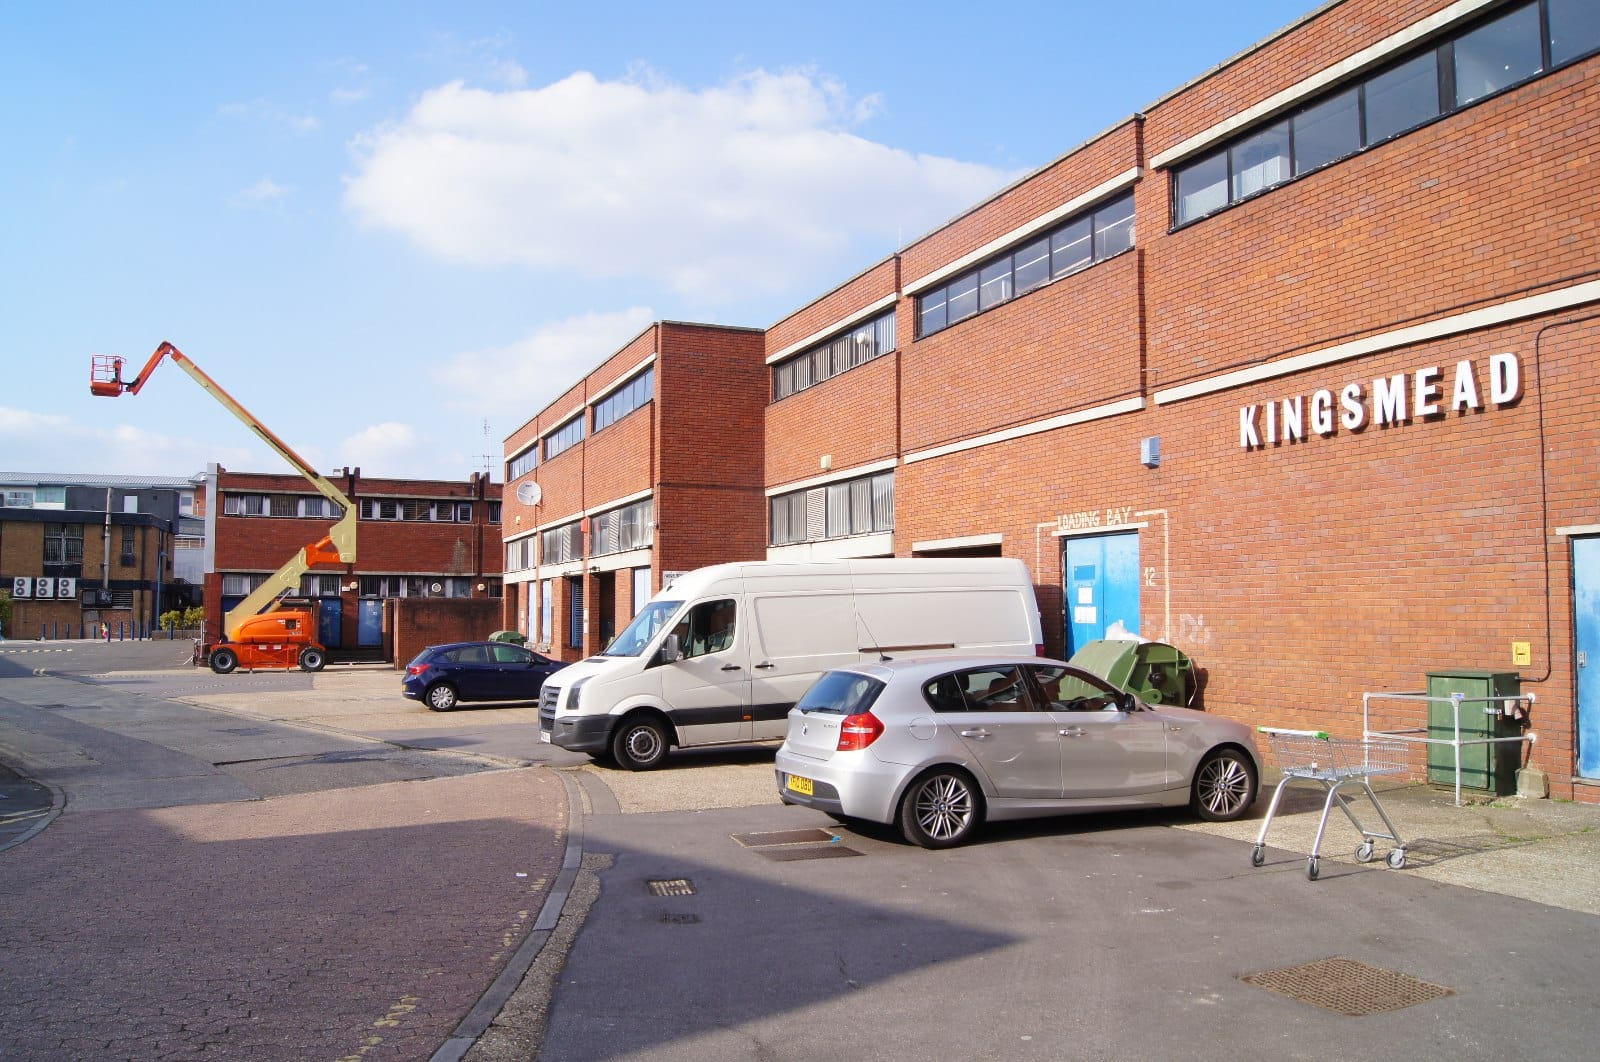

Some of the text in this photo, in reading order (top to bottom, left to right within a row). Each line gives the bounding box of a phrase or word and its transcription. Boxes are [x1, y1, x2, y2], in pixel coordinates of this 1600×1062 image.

[1239, 352, 1522, 448] KINGSMEAD
[1057, 506, 1131, 531] LOADING BAY
[1144, 566, 1156, 587] 12
